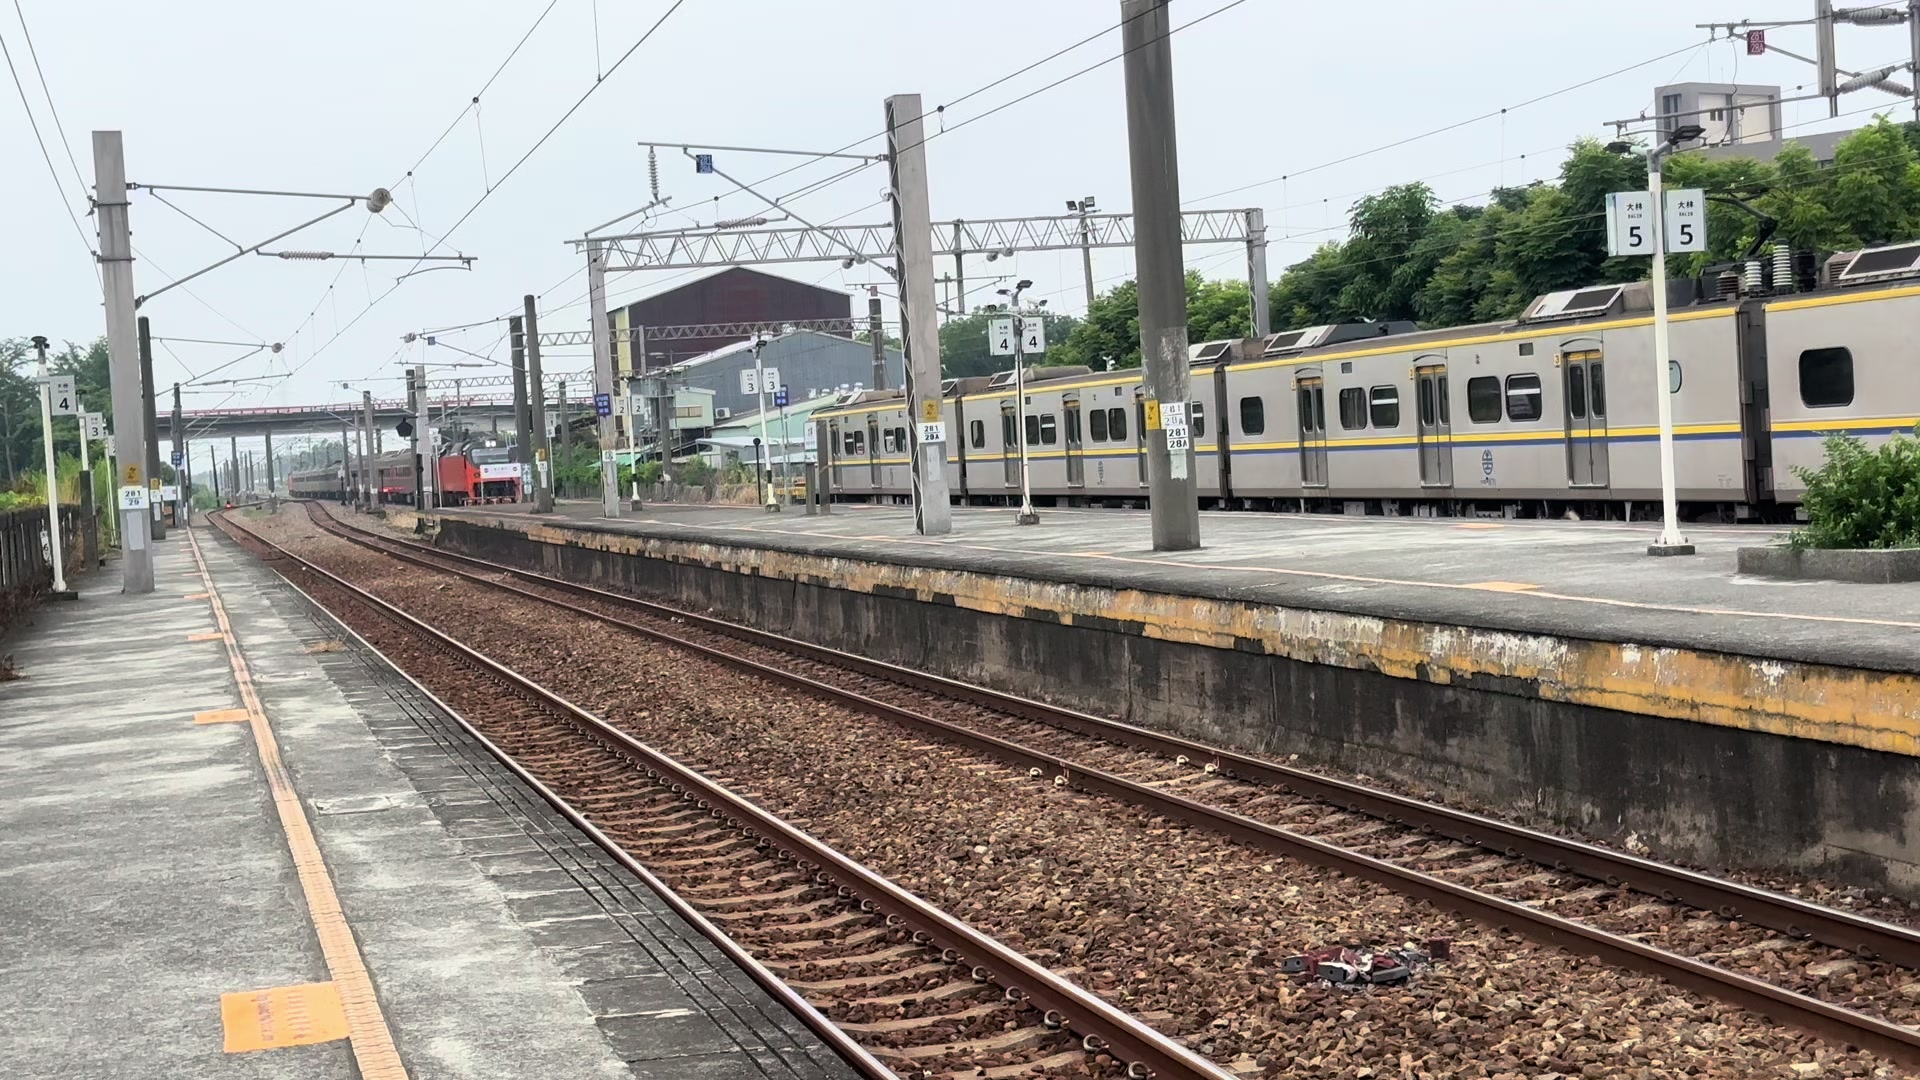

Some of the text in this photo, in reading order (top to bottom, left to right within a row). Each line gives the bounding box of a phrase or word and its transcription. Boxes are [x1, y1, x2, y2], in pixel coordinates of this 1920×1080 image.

[1626, 202, 1643, 211] 大林
[1677, 201, 1694, 209] 大林
[1629, 226, 1642, 247] 5
[1680, 224, 1693, 245] 5
[1000, 338, 1008, 350] 4
[1029, 336, 1037, 348] 4
[748, 382, 754, 392] 3
[769, 381, 775, 390] 3
[59, 397, 69, 410] 4
[91, 427, 98, 436] 3
[1168, 428, 1186, 437] 281
[1169, 440, 1188, 448] 28A
